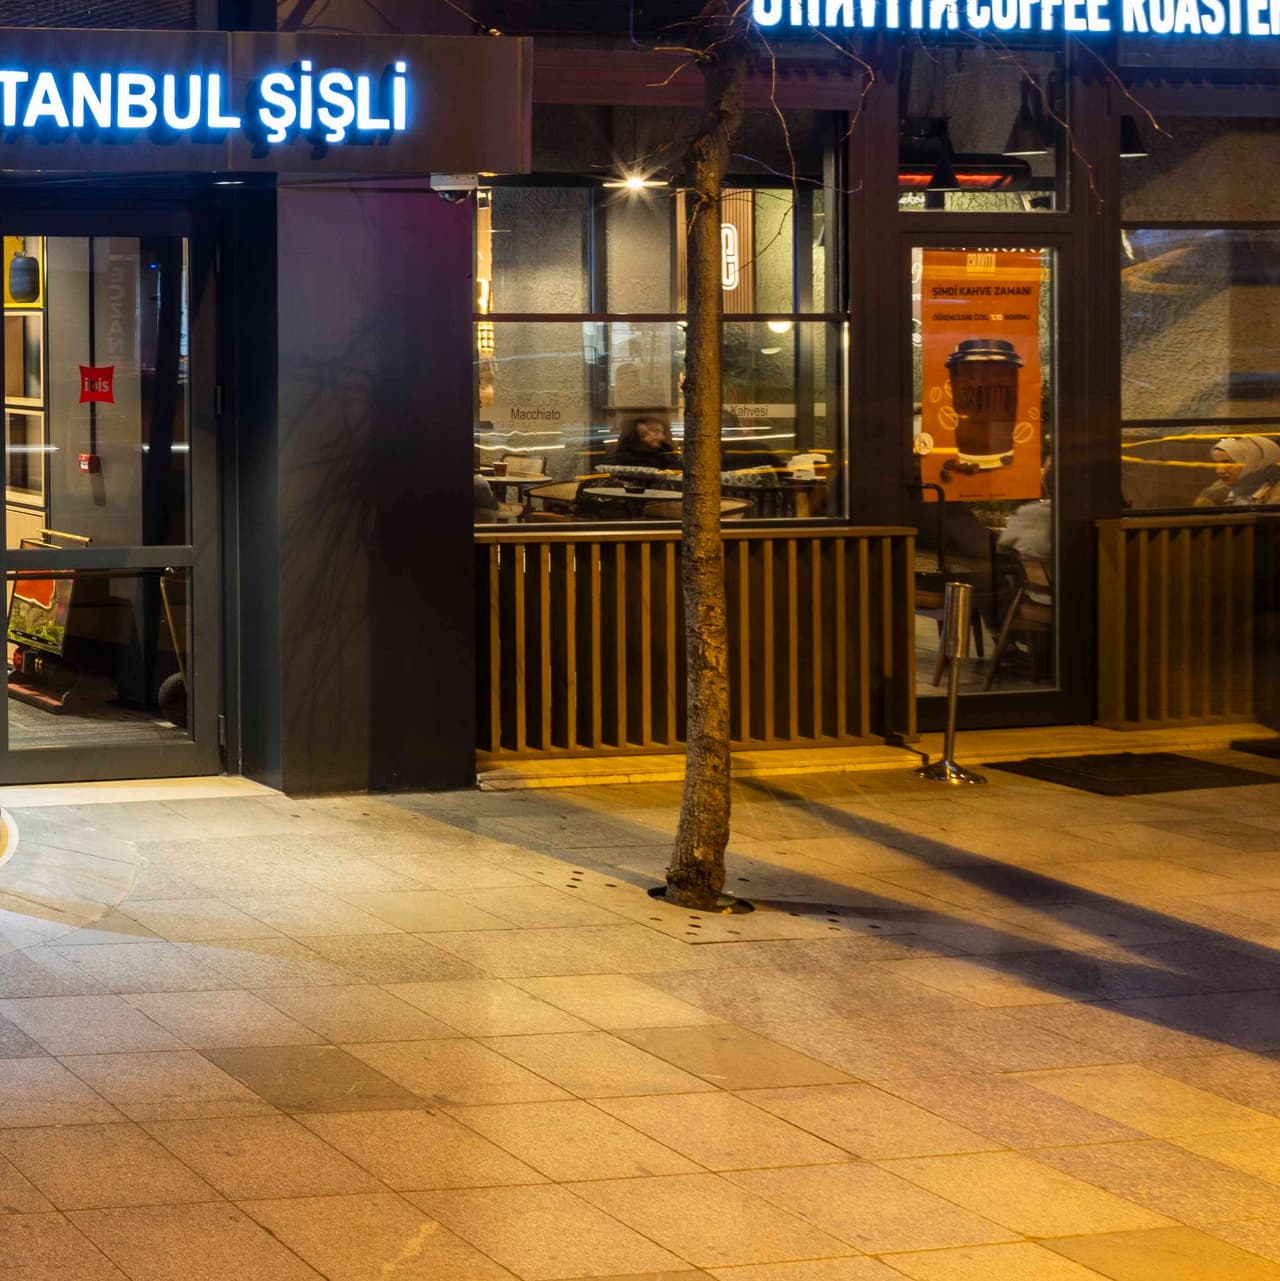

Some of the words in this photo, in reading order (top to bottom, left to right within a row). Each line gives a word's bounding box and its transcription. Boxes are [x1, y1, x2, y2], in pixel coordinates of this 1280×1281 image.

[258, 59, 408, 144] ŞİŞLİ
[959, 287, 992, 296] KAHVE
[994, 287, 1032, 296] ZAMANI
[83, 376, 110, 393] ibis
[510, 407, 560, 420] Macchiato
[731, 405, 768, 417] Kahvesi
